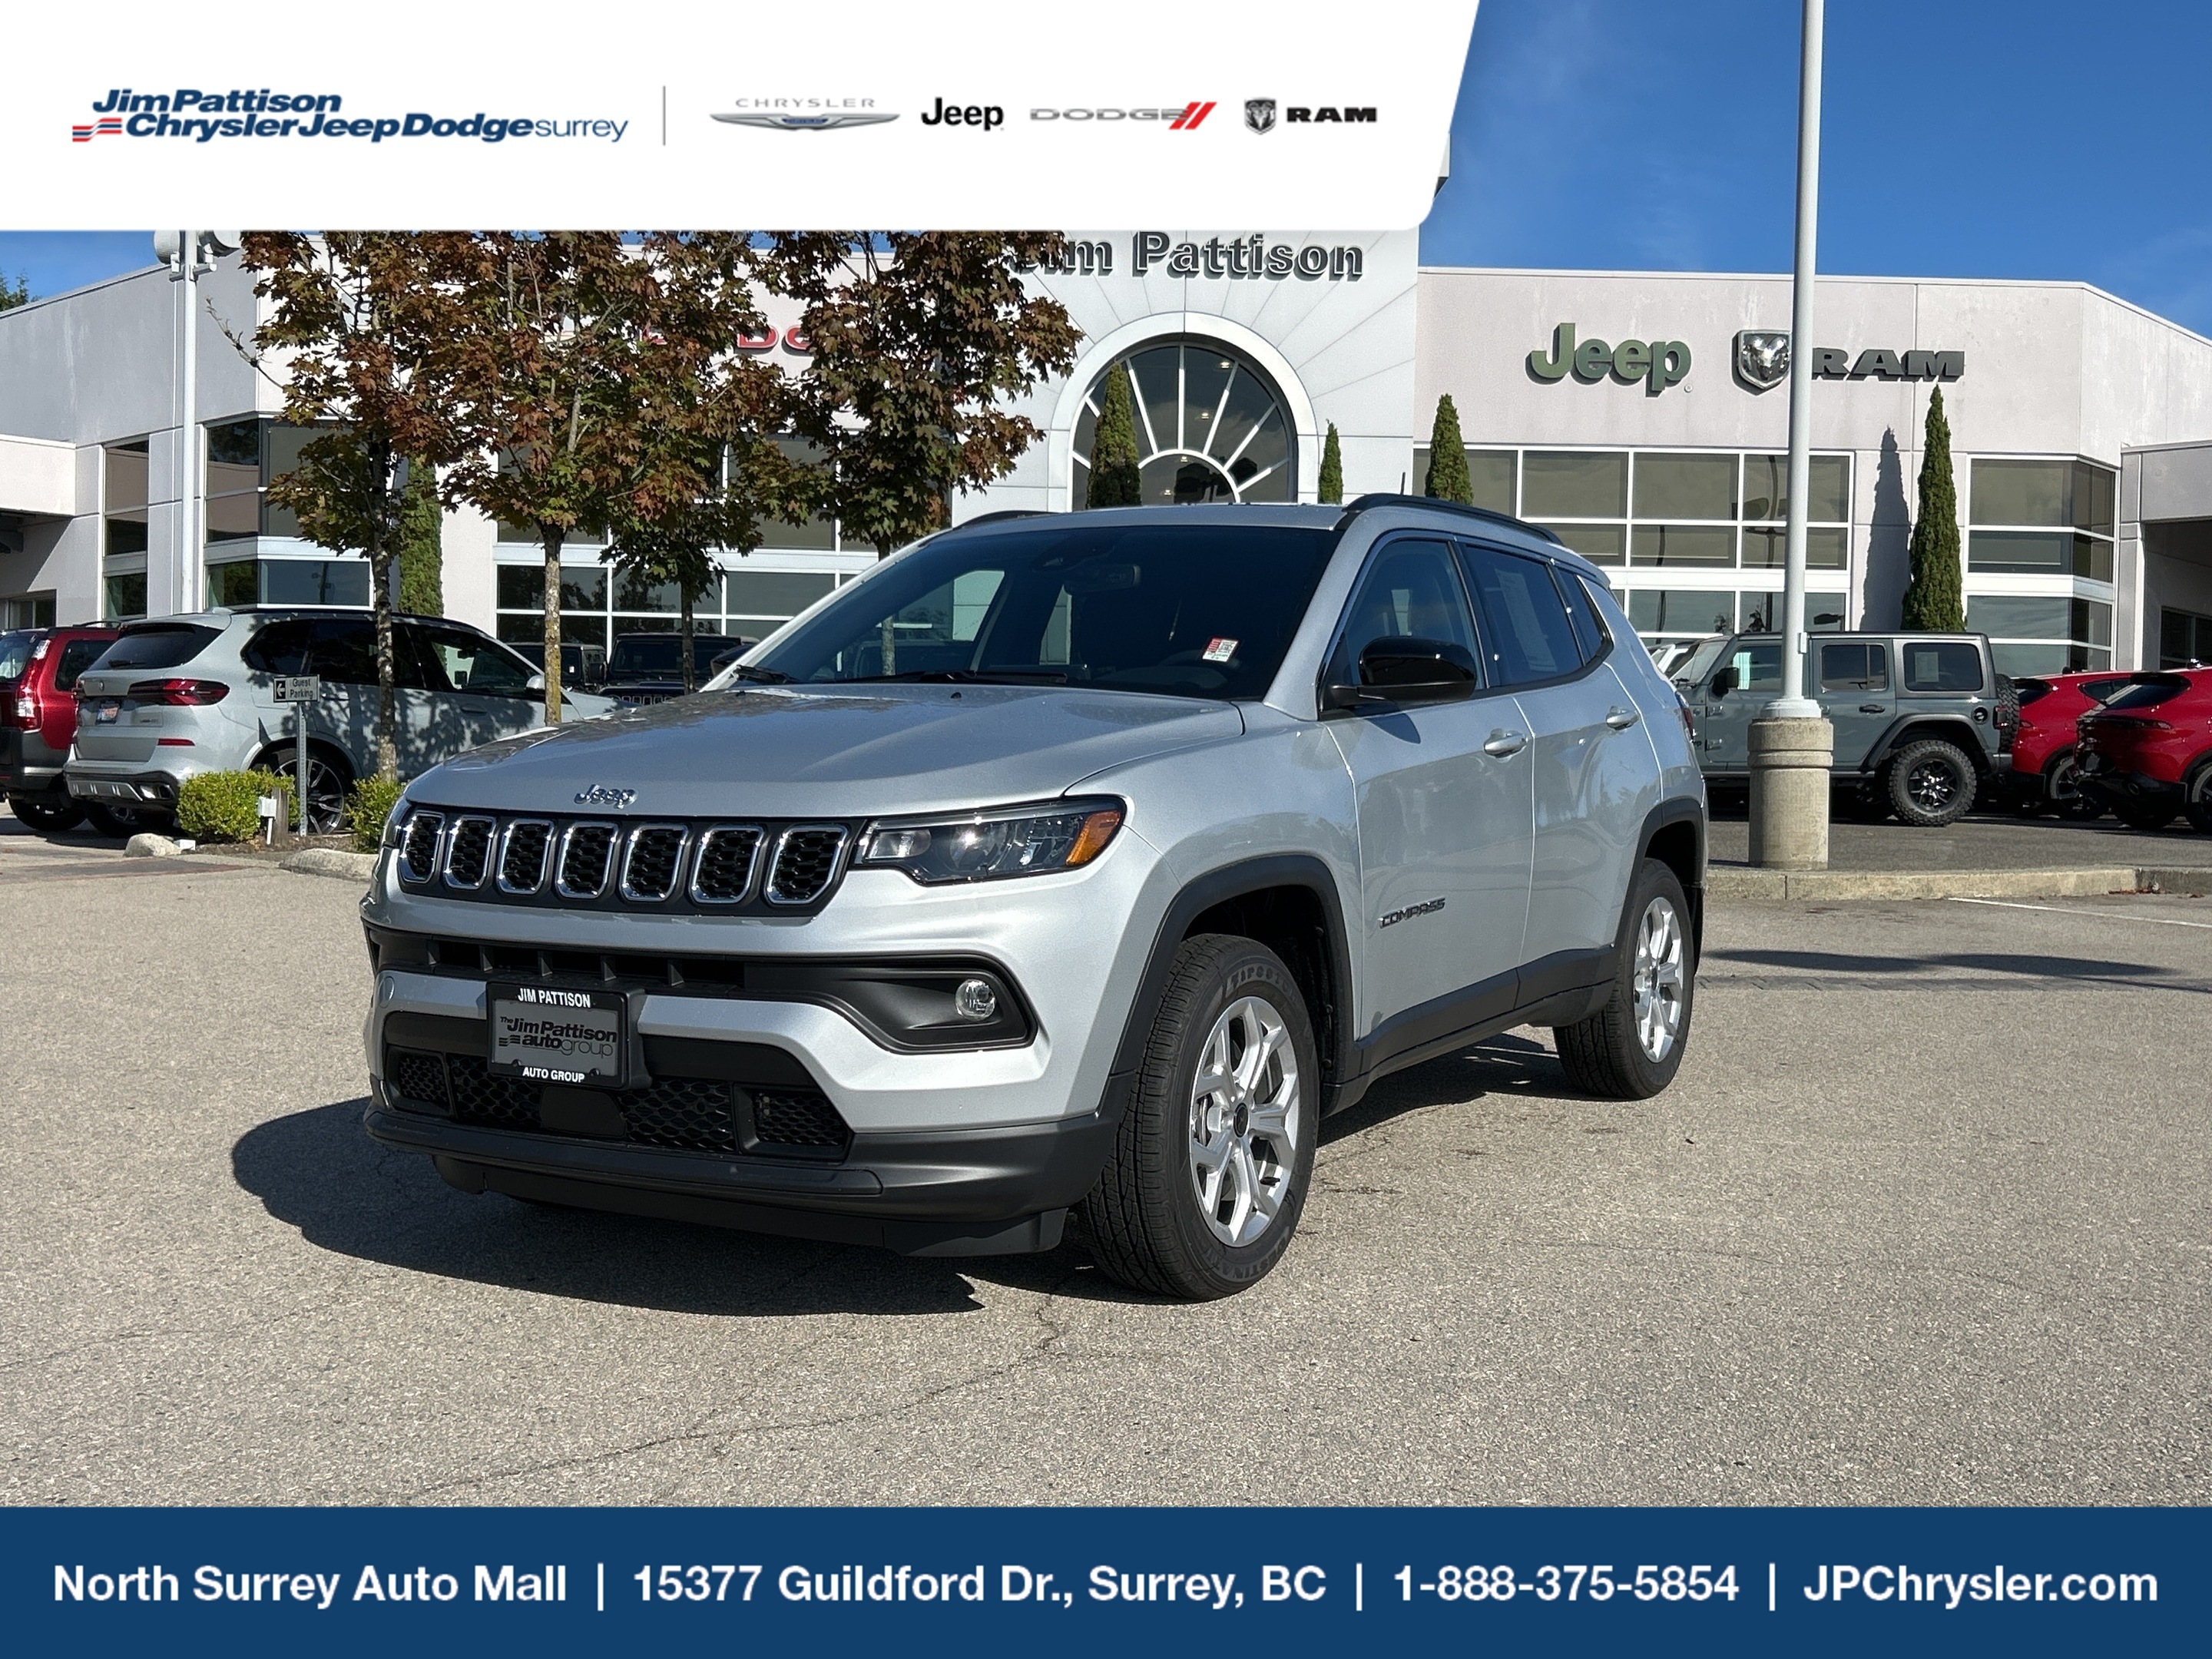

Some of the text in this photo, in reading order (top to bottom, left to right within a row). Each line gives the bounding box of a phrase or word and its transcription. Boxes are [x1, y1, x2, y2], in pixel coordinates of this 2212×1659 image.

[1135, 231, 1364, 279] Pattison
[1528, 323, 1691, 393] Jeep
[1812, 347, 1965, 380] RAM
[290, 689, 313, 700] Parking
[292, 678, 311, 687] Guest
[574, 784, 637, 810] Jeep
[1378, 897, 1445, 929] COMPASS
[518, 988, 591, 1008] JIM PATTISON
[500, 1016, 617, 1043] The Jim Pattison
[522, 1067, 585, 1083] AUTO GROUP
